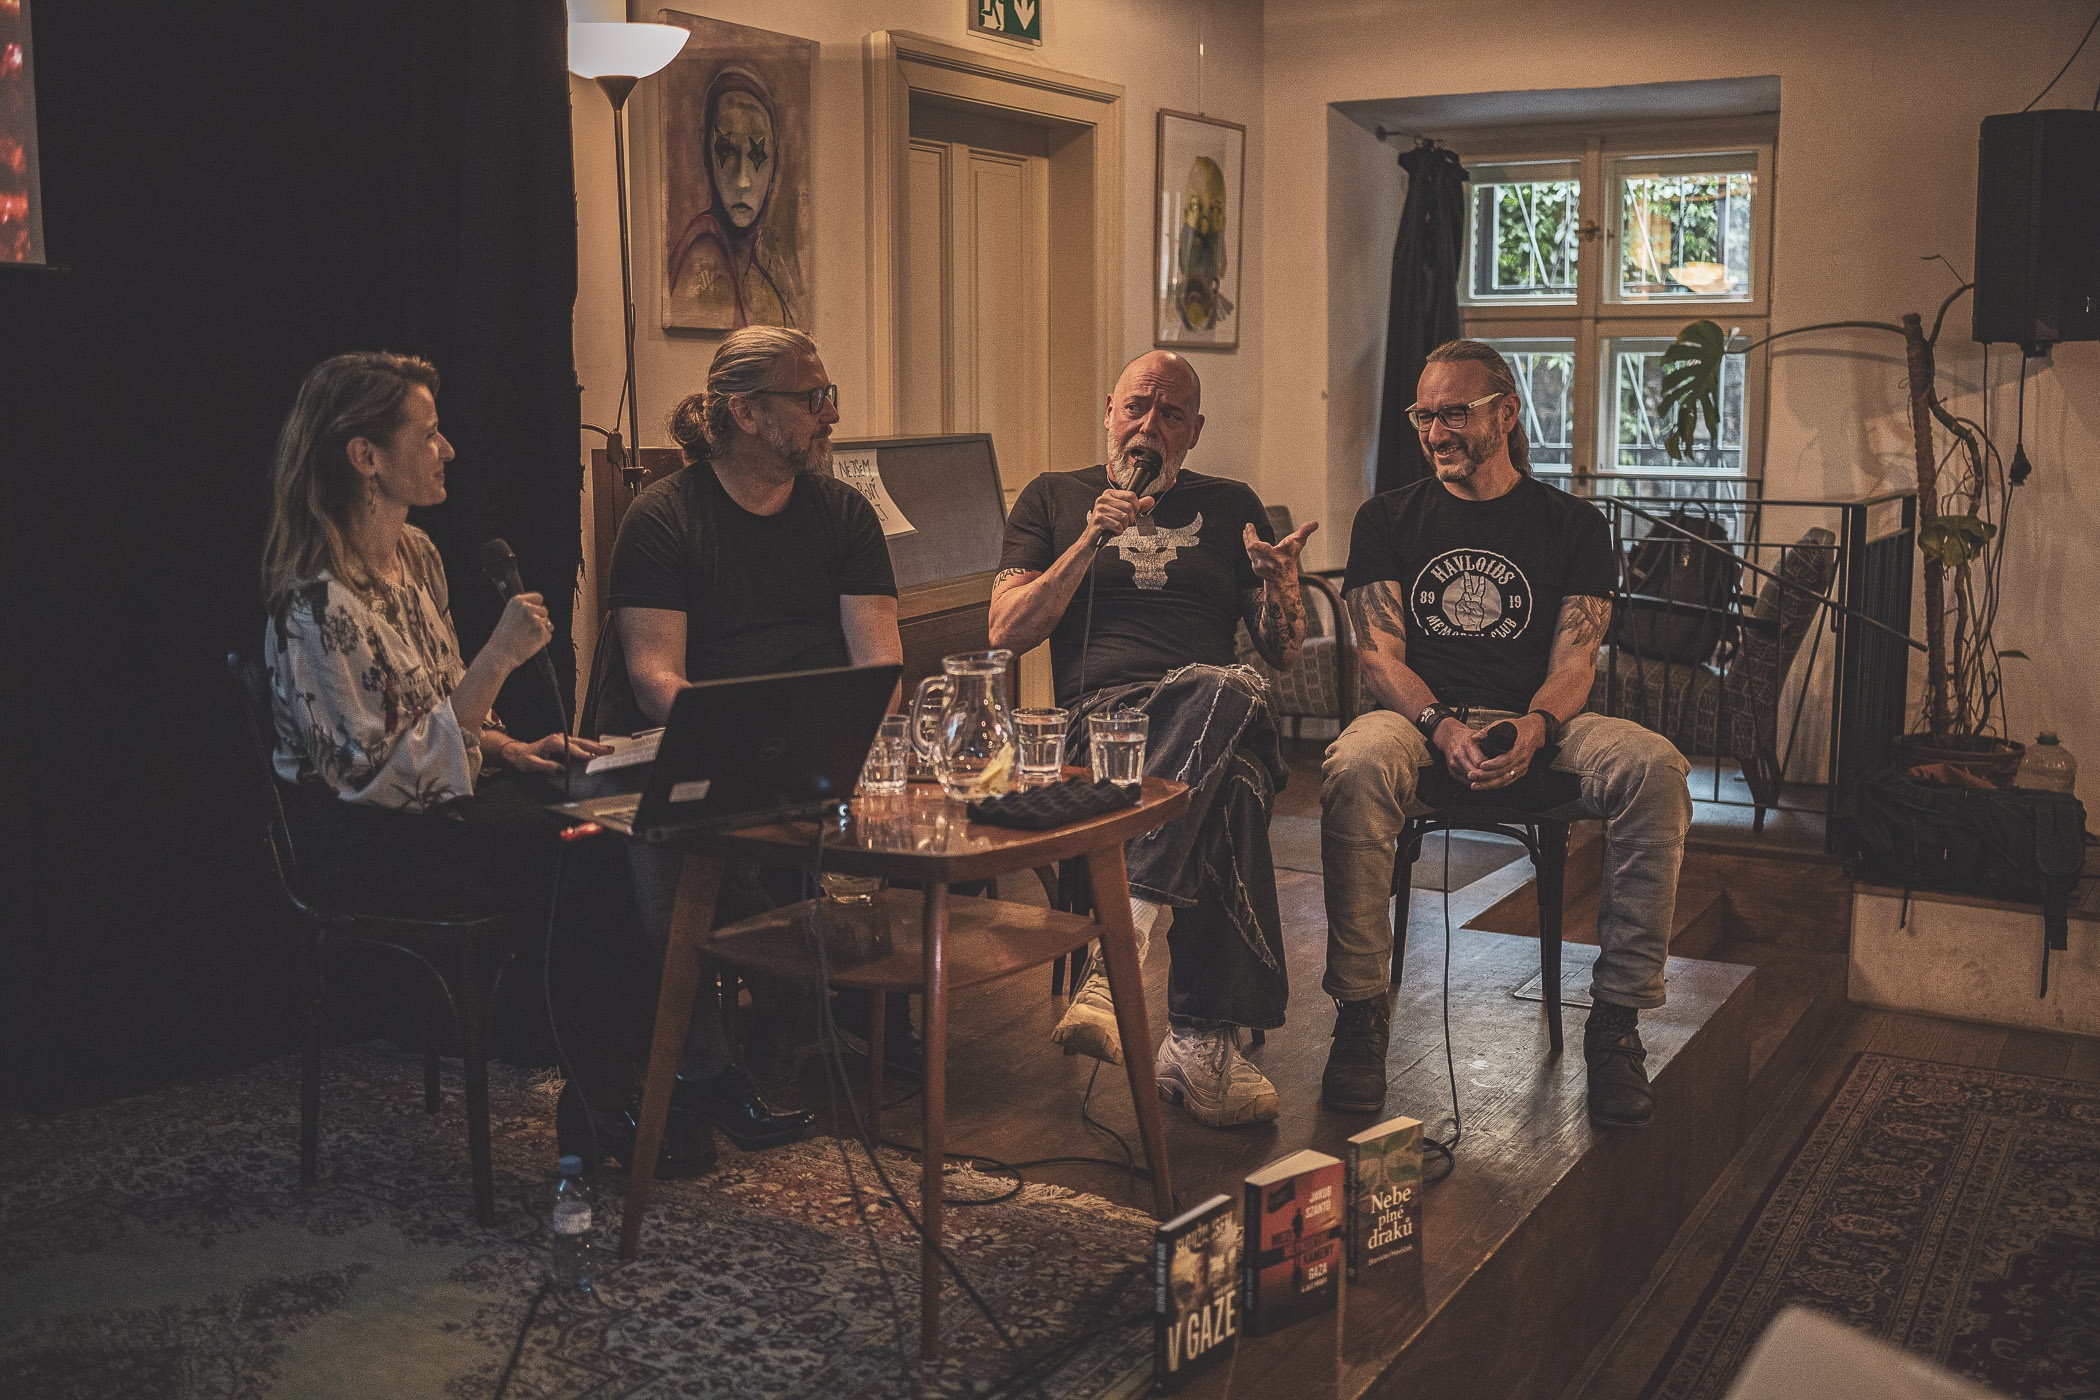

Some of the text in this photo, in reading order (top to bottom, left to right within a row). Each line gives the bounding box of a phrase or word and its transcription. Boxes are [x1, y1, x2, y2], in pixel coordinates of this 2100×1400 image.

[1430, 555, 1516, 585] HAVLOIDS
[1420, 591, 1435, 604] 89
[1509, 595, 1522, 609] 19
[1370, 1185, 1412, 1214] Nebe
[1378, 1204, 1404, 1231] plné
[1368, 1216, 1413, 1249] draků
[1168, 1289, 1236, 1372] V GAZE
